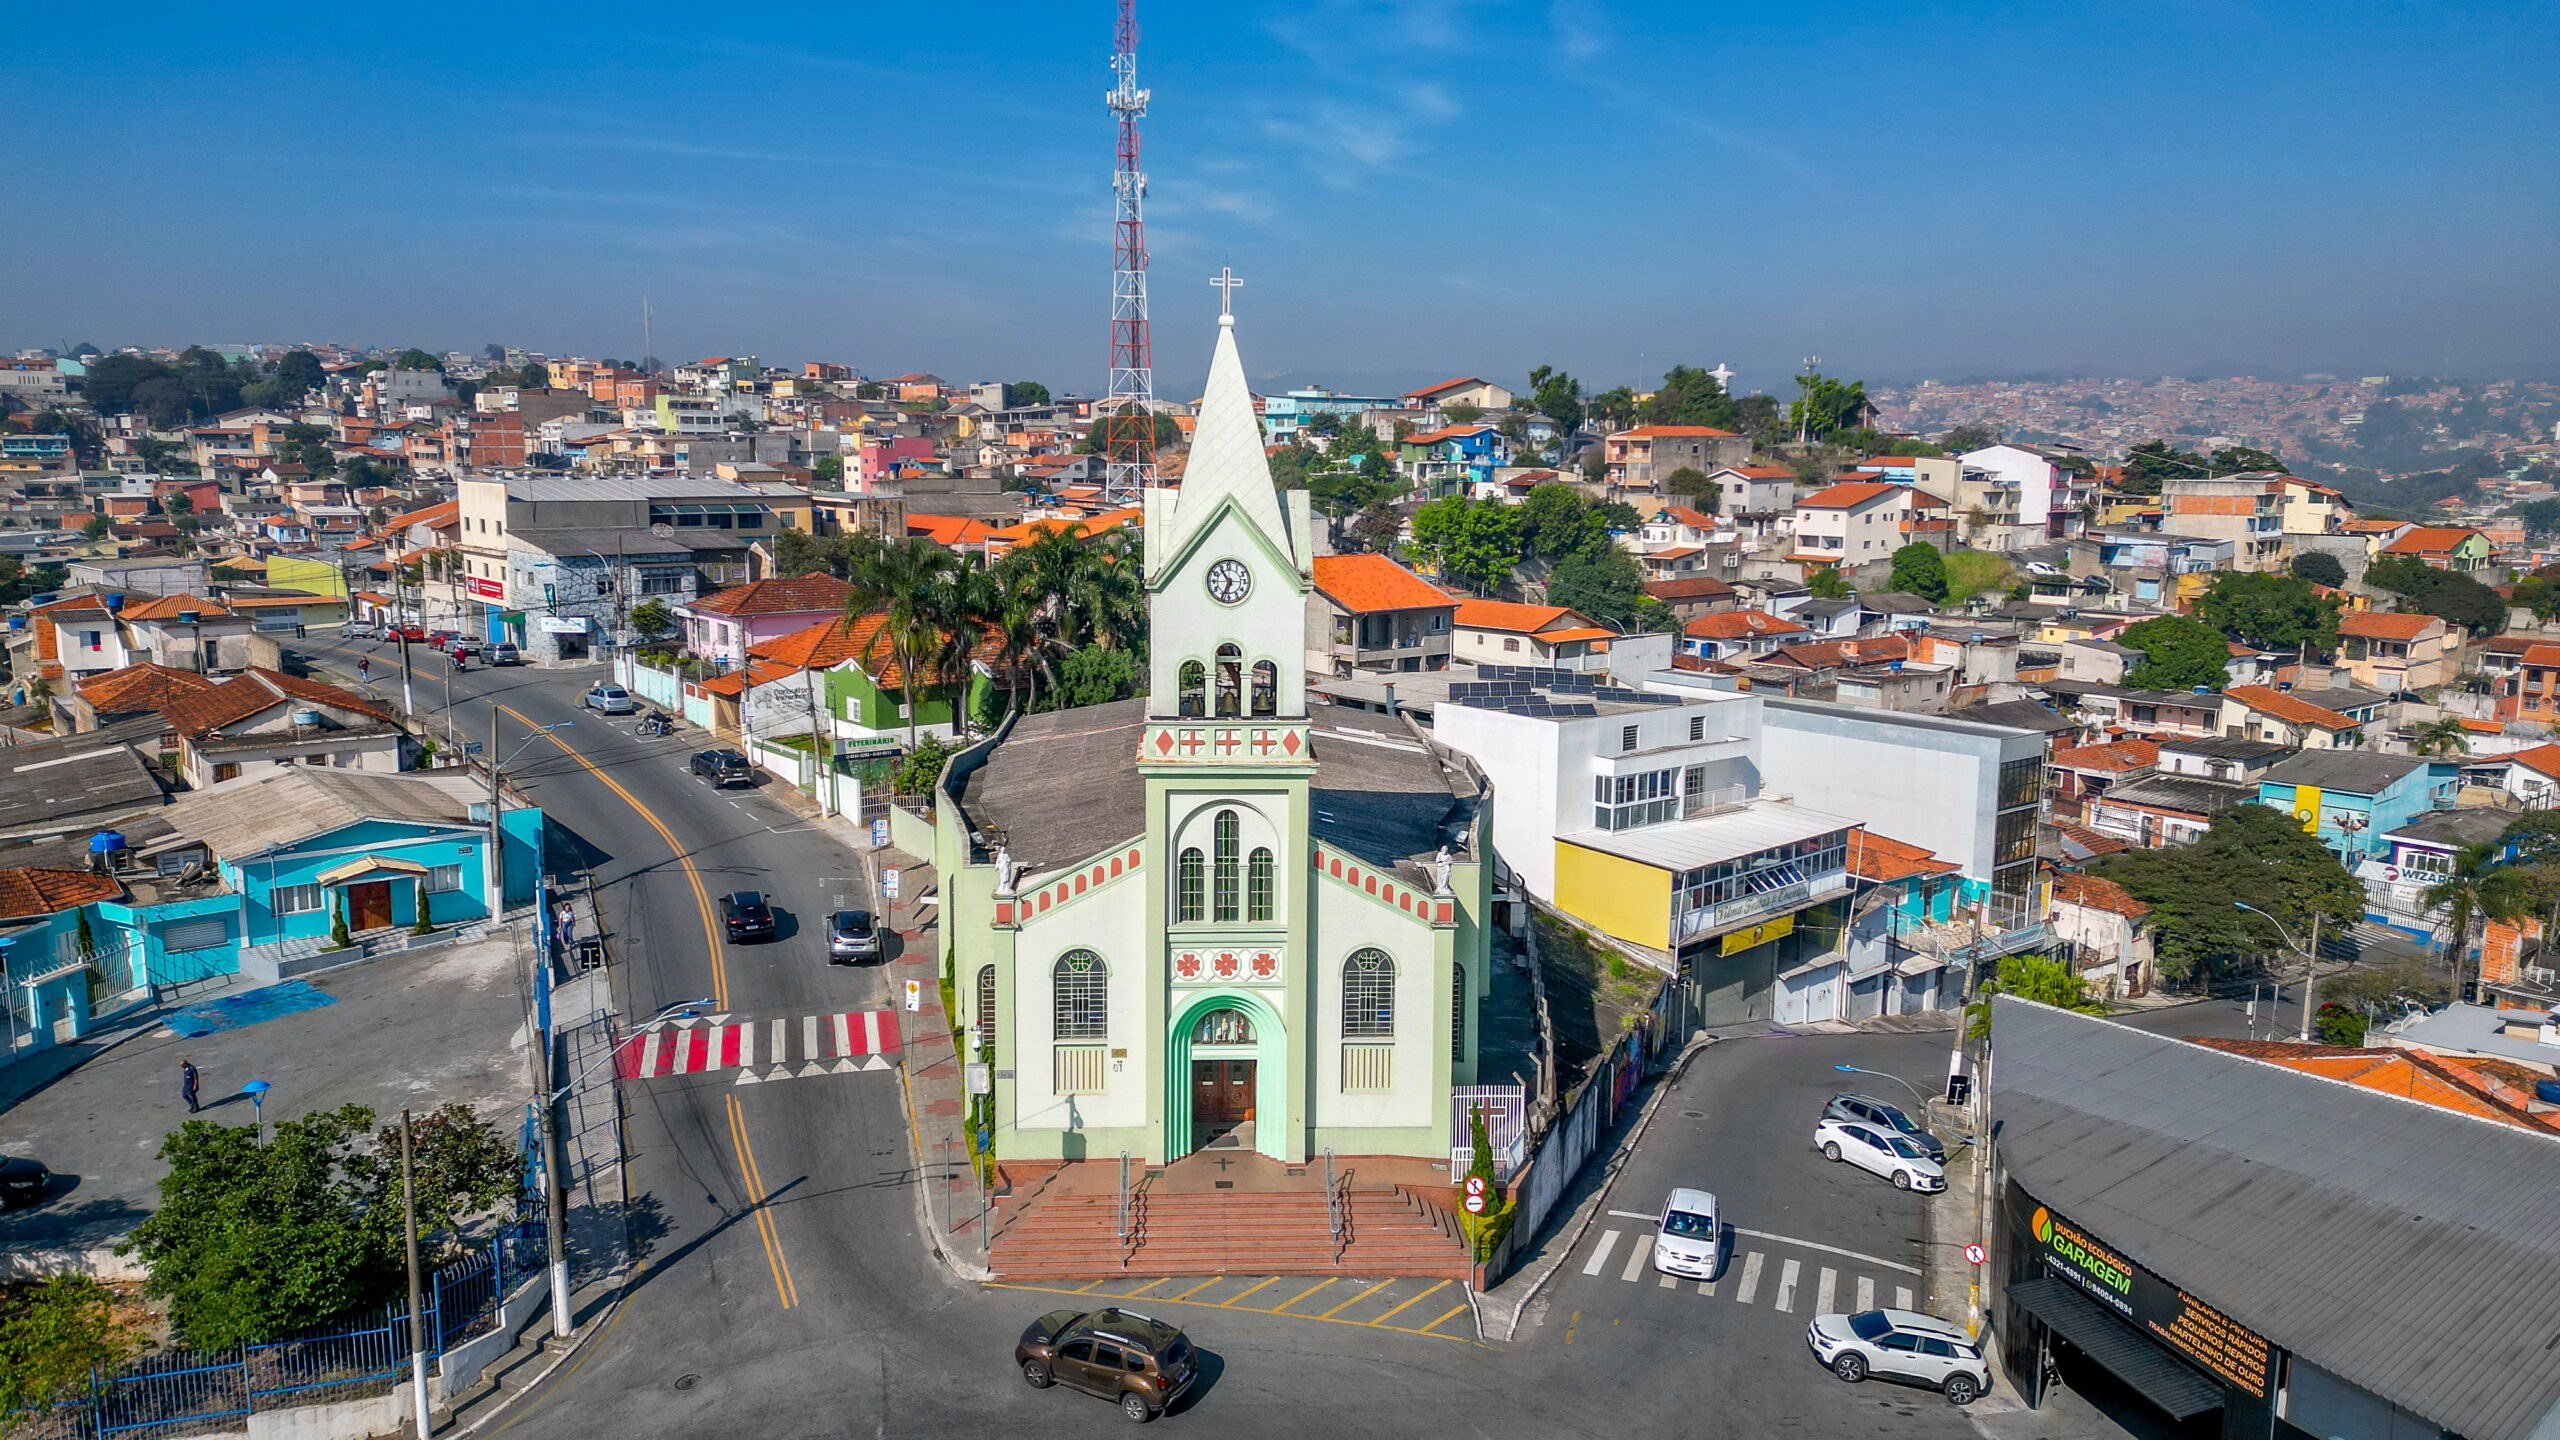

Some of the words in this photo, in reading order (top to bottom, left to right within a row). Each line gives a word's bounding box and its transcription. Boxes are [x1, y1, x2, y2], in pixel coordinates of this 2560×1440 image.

[2053, 1234, 2132, 1295] GARAGEM
[2055, 1222, 2087, 1248] DUCHÃO
[2088, 1242, 2133, 1277] ECOLÓGICO
[2177, 1291, 2221, 1322] FUNILARIA
[2222, 1316, 2229, 1327] E
[2229, 1322, 2268, 1350] PINTURA
[2177, 1315, 2223, 1349] PEQUENOS
[2224, 1344, 2266, 1375] REPAROS
[2184, 1306, 2226, 1338] SERVIÇOS
[2227, 1334, 2268, 1363] RÁPIDOS
[2148, 1319, 2195, 1355] TRABALHAMOS
[2195, 1351, 2212, 1366] COM
[2211, 1362, 2264, 1398] AGENDAMENTO
[2169, 1322, 2223, 1362] MARTELINHO
[2224, 1357, 2238, 1370] DE
[2238, 1366, 2265, 1388] OURO
